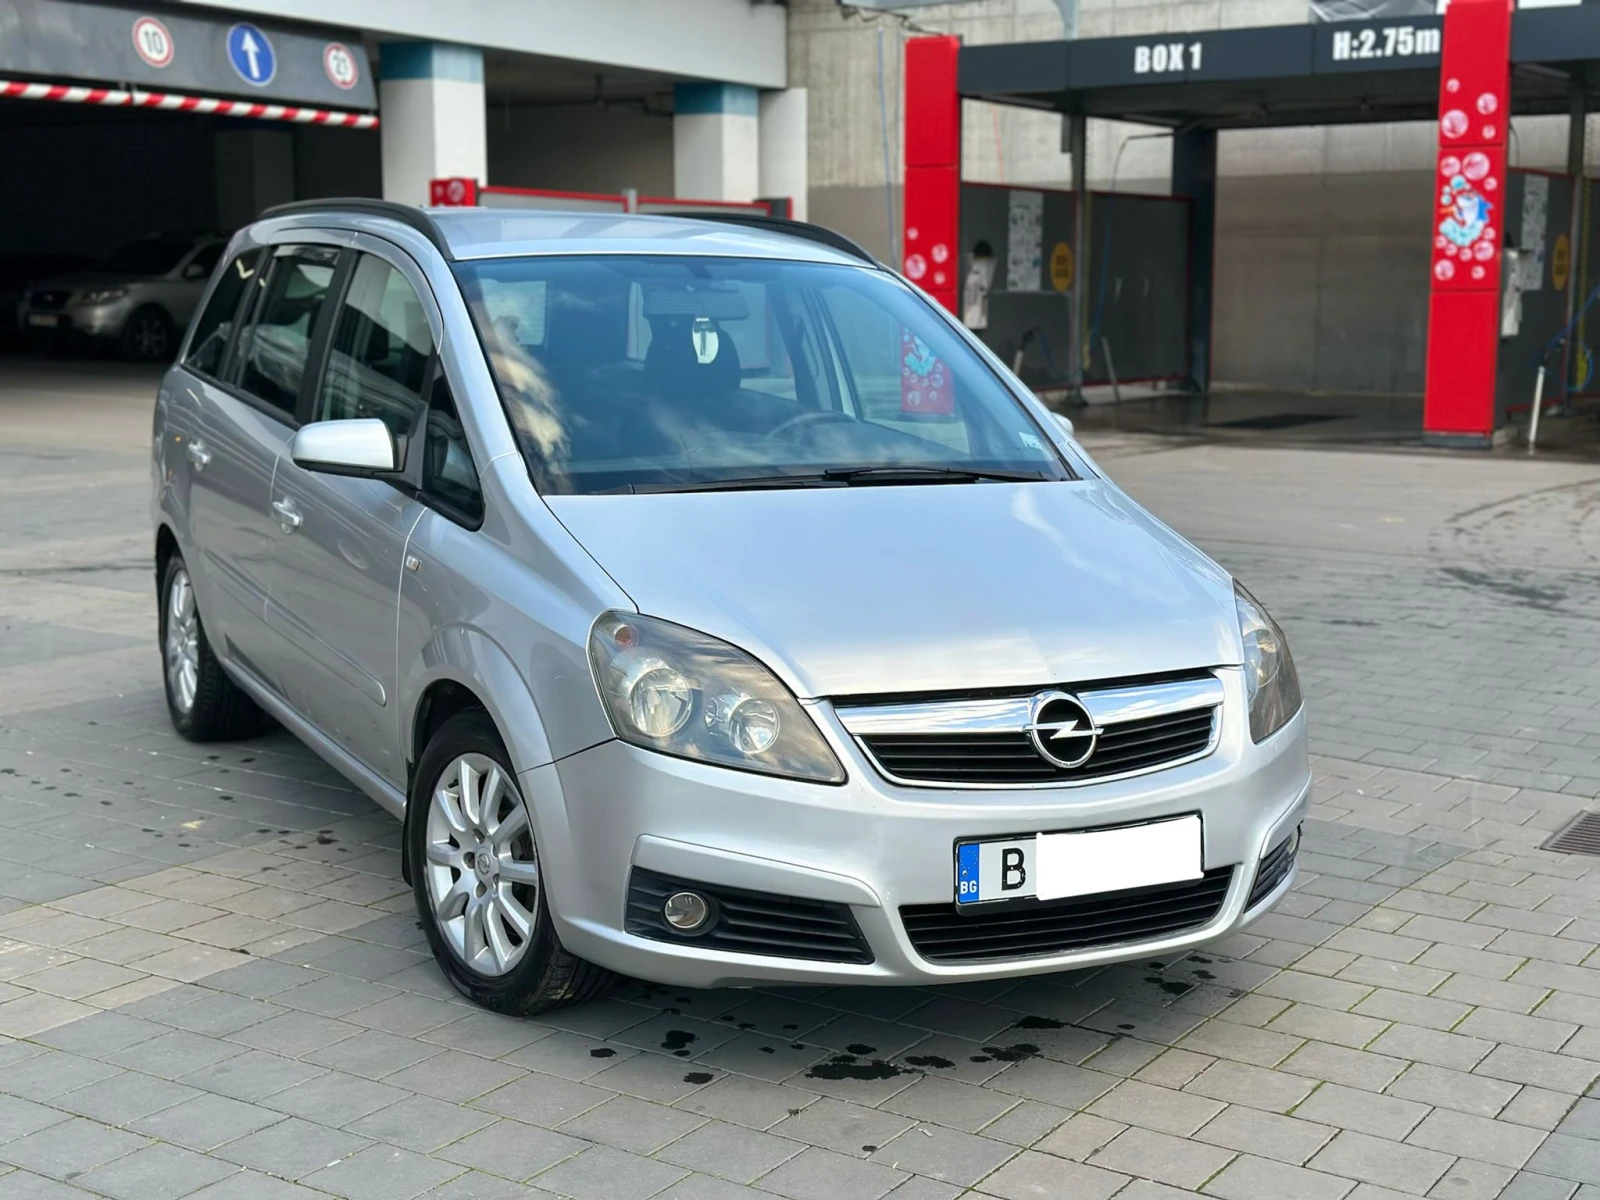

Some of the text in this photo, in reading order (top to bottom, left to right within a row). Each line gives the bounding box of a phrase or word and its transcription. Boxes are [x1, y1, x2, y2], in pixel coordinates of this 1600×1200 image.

[144, 30, 165, 54] 10
[1134, 42, 1202, 73] BOX 1
[1332, 25, 1440, 60] H:2.75m
[1002, 847, 1026, 891] B
[960, 880, 978, 895] BG
